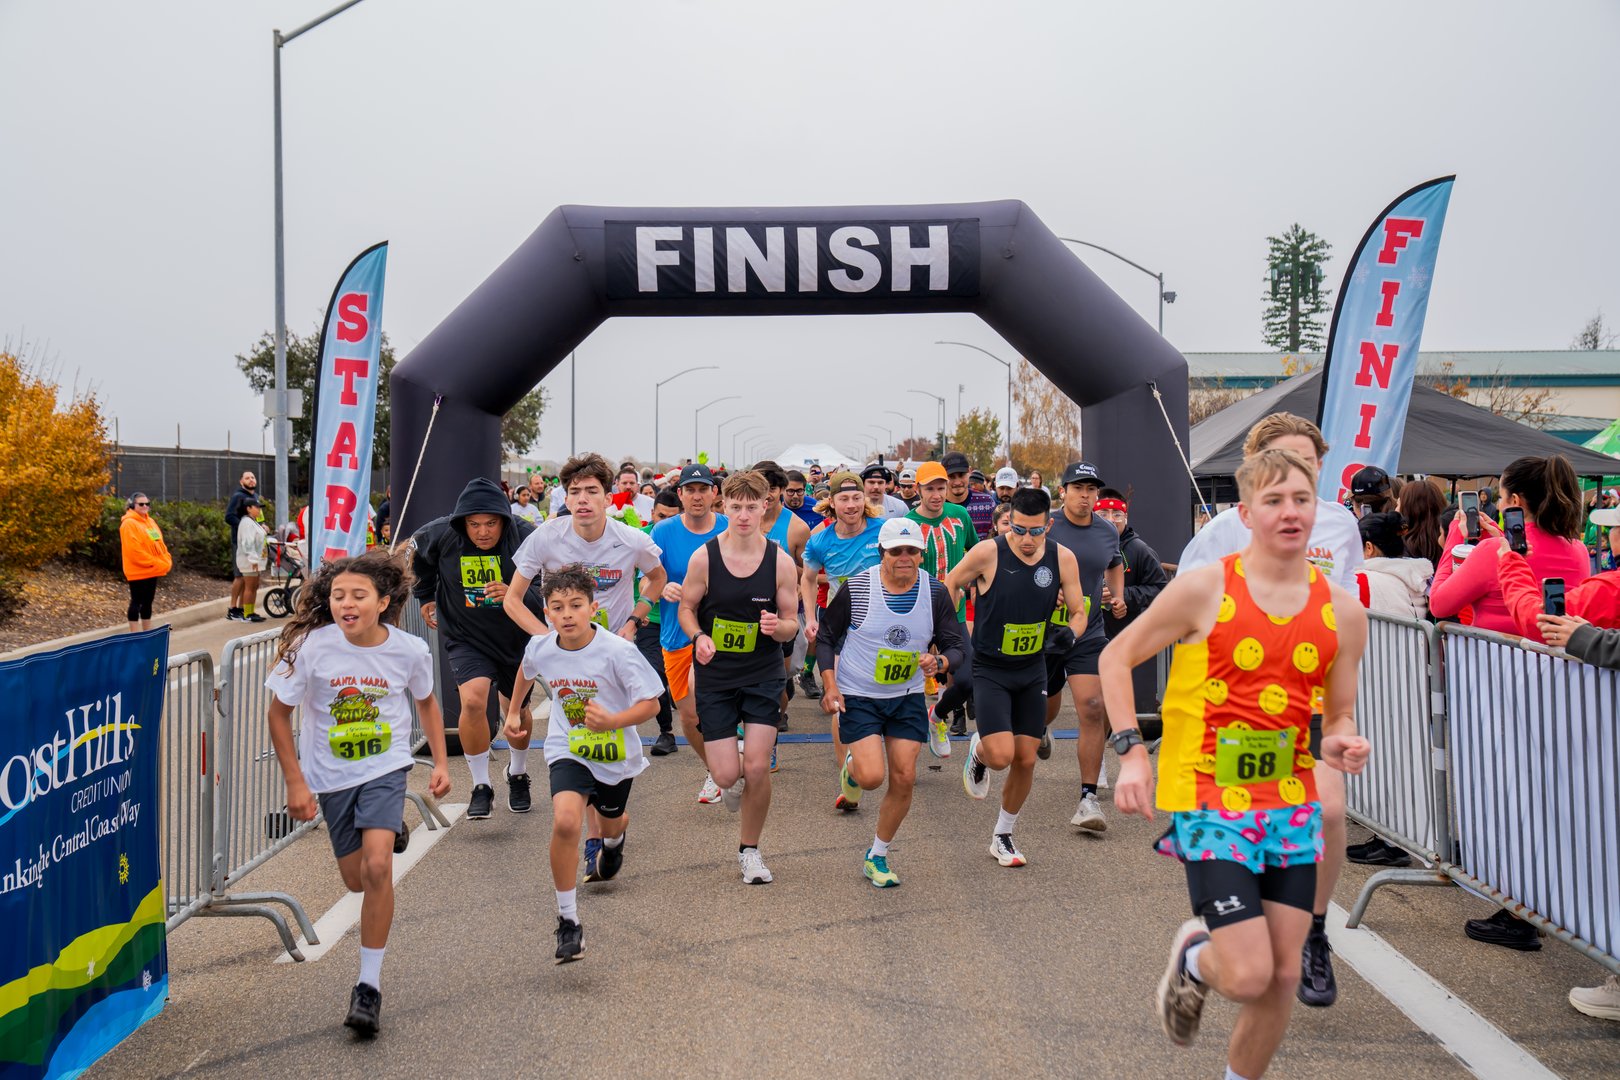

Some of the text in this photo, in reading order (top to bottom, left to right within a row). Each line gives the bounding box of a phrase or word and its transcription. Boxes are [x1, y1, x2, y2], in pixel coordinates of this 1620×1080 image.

[635, 225, 950, 293] FINISH
[323, 293, 369, 558] STAR
[466, 568, 496, 585] 340
[723, 632, 746, 650] 94
[1011, 635, 1038, 652] 137
[330, 676, 389, 689] SANTA MARIA
[883, 664, 912, 682] 184
[549, 678, 598, 689] SANTA MARIA
[339, 738, 382, 758] 316
[577, 742, 619, 762] 240
[1237, 751, 1276, 780] 68
[71, 780, 102, 813] CREDIT
[0, 858, 43, 893] nking
[91, 813, 119, 842] Coast
[120, 798, 141, 827] Way
